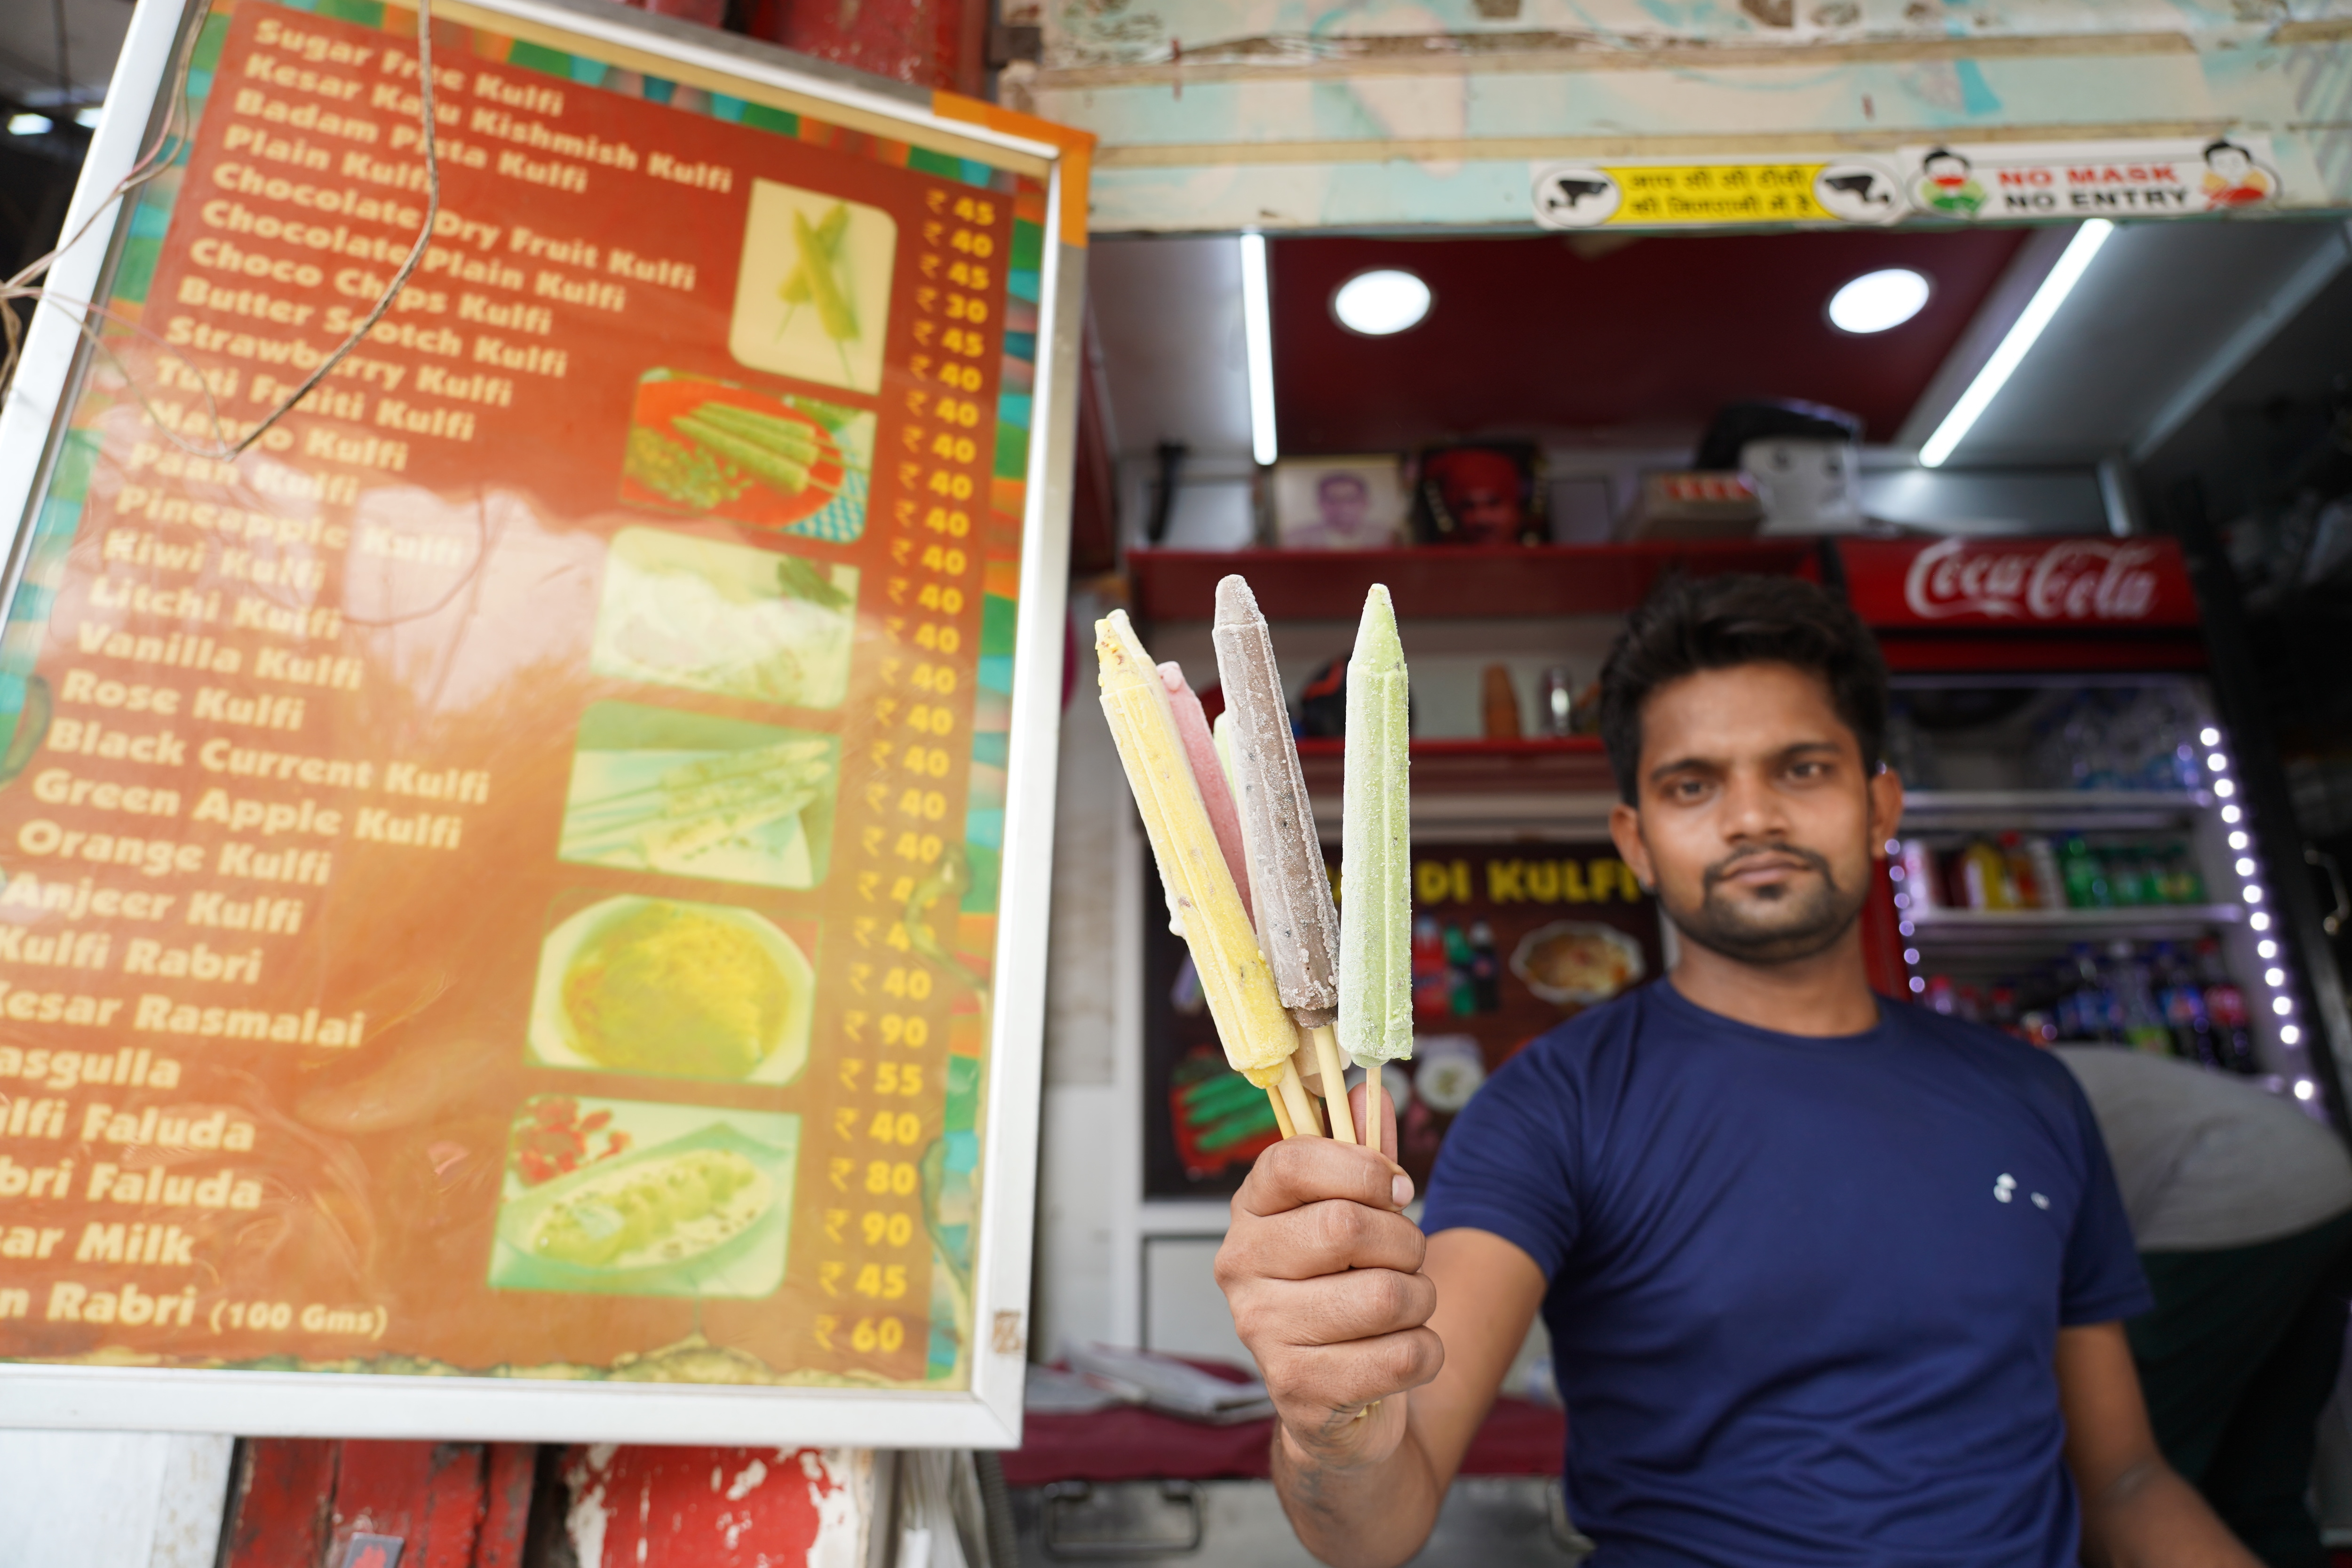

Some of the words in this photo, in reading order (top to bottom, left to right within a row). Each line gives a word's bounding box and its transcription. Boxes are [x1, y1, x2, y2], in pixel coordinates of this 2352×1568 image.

[254, 19, 373, 67] Sugar
[474, 72, 564, 117] Kulfi
[234, 88, 378, 143] Badam
[497, 150, 588, 194] Kulfi
[245, 53, 363, 100] Kesar
[370, 83, 461, 127] Kau
[471, 106, 638, 171] Kishmish
[647, 151, 733, 193] Kulfi
[223, 123, 331, 172] Plain
[1998, 167, 2055, 189] NO
[2066, 163, 2178, 186] MASK
[953, 196, 995, 226] 45
[2004, 192, 2055, 212] NO
[2072, 186, 2189, 209] ENTRY
[213, 162, 421, 229] Chocolate
[432, 208, 501, 251] Dry
[509, 225, 599, 270] Fruit
[607, 248, 697, 292] Kulfi
[950, 229, 993, 258] 40
[202, 199, 411, 267] Chocolate
[423, 246, 525, 291] Plain
[533, 270, 626, 312] Kulfi
[190, 237, 323, 288] Choco
[334, 268, 448, 314] Chps
[458, 292, 552, 335] Kulfi
[947, 260, 990, 290] 45
[177, 276, 315, 326] Butter
[473, 335, 569, 378] Kulfi
[945, 293, 988, 324] 30
[941, 327, 985, 357] 45
[415, 365, 513, 407] Kulfi
[938, 362, 982, 392] 40
[375, 398, 475, 442] Kulfi
[934, 396, 979, 428] 40
[305, 427, 408, 471] Kulfi
[931, 433, 977, 464] 40
[928, 470, 973, 501] 40
[114, 484, 349, 549] Pineapple
[924, 506, 970, 538] 40
[103, 528, 206, 573] Kiwi
[220, 547, 325, 591] Kulfi
[921, 544, 966, 576] 40
[89, 574, 220, 622] Litchi
[234, 595, 343, 640] Kulfi
[917, 582, 963, 615] 40
[78, 621, 242, 673] Vanilla
[253, 645, 363, 691] Kulfi
[914, 622, 960, 654] 40
[911, 662, 957, 695] 40
[60, 667, 181, 716] Rose
[192, 685, 305, 731] Kulfi
[906, 703, 954, 736] 40
[47, 716, 186, 766] Black
[199, 737, 373, 790] Current
[384, 761, 491, 805] Kulfi
[903, 745, 950, 778] 40
[32, 767, 181, 817] Green
[191, 787, 343, 836] Apple
[354, 805, 463, 851] Kulfi
[899, 788, 946, 821] 40
[17, 819, 205, 877] Orange
[216, 841, 333, 885] Kulfi
[896, 831, 942, 864] 40
[890, 875, 938, 909] 4
[1486, 858, 1639, 904] KULFI
[1, 870, 176, 921] Anjeer
[186, 890, 304, 935] Kulfi
[0, 924, 111, 971] Kulfi
[123, 937, 263, 985] Rabri
[886, 922, 935, 953] 4
[882, 966, 933, 1001] 40
[133, 992, 366, 1048] Rasmalai
[879, 1012, 929, 1049] 90
[874, 1061, 923, 1096] 55
[80, 1103, 256, 1152] Faluda
[868, 1109, 921, 1146] 40
[85, 1162, 263, 1210] Faluda
[865, 1159, 918, 1196] 80
[0, 1224, 64, 1259] ar
[75, 1222, 195, 1266] Milk
[862, 1210, 913, 1248] 90
[855, 1262, 907, 1300] 45
[46, 1281, 198, 1326] Rabri
[209, 1298, 293, 1335] (100
[300, 1302, 389, 1341] Gms)
[851, 1316, 904, 1353] 60
